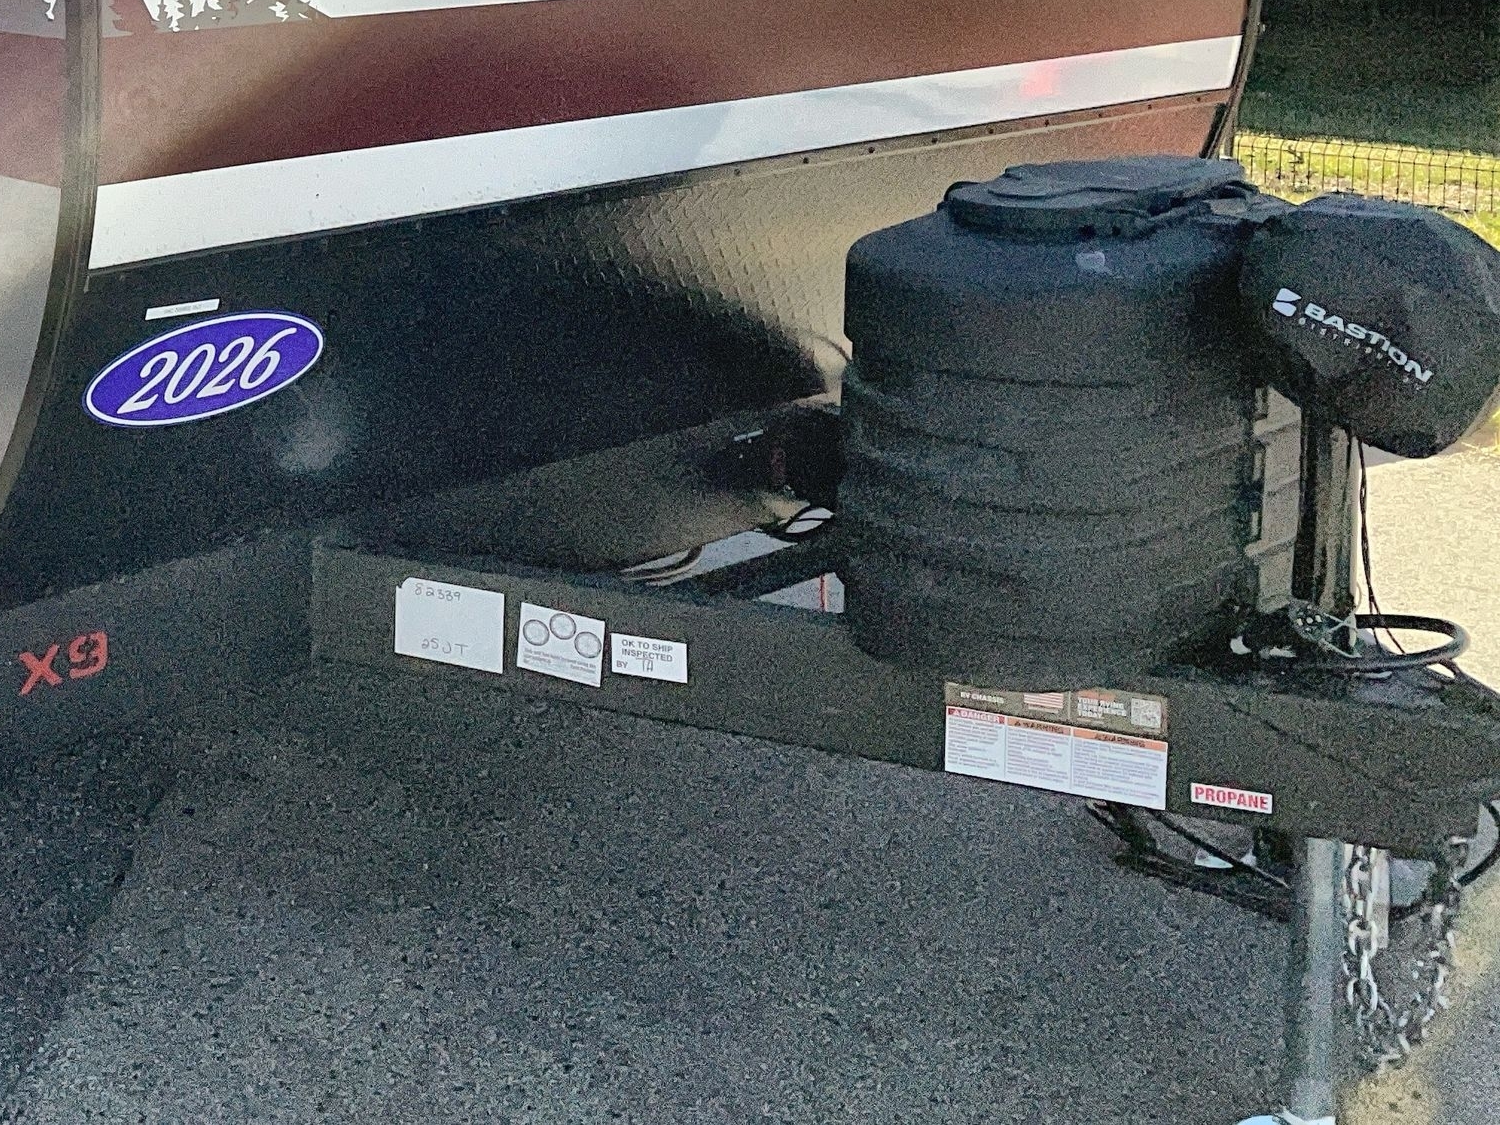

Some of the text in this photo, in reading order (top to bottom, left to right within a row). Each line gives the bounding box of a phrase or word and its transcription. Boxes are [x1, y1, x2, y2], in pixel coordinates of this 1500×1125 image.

[1304, 302, 1434, 383] BASTION
[116, 327, 298, 415] 2026
[621, 638, 674, 653] OK TO SHIP
[621, 648, 673, 663] INSPECTED
[616, 660, 628, 669] BY
[961, 710, 1002, 724] DANGER
[1194, 786, 1269, 811] PROPANE
